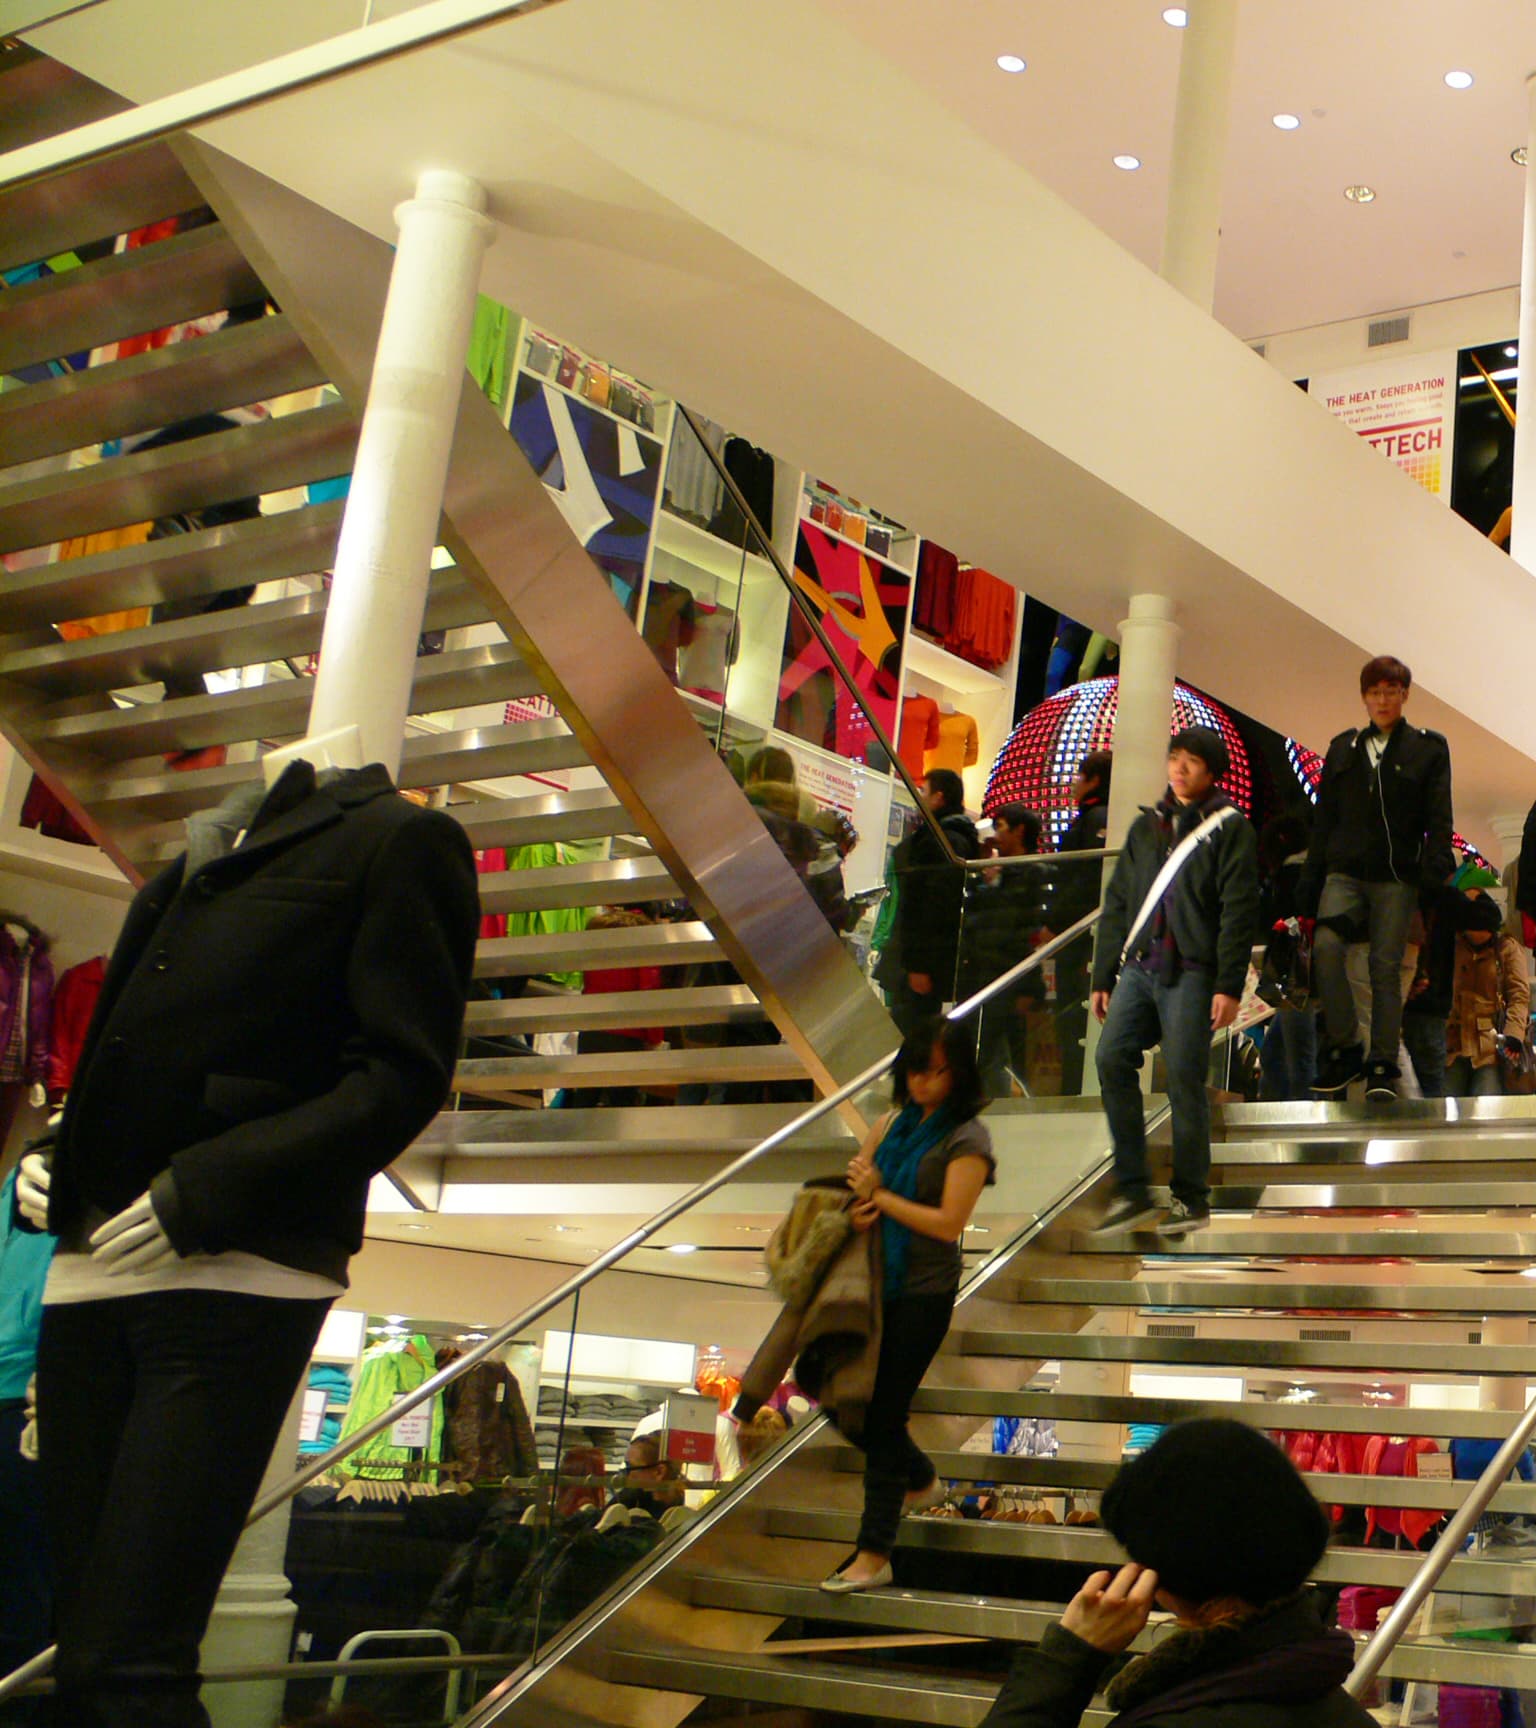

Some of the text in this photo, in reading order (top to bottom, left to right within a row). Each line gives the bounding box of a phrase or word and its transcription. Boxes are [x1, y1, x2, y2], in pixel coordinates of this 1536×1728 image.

[1326, 377, 1445, 408] THE HEAT GENERATION
